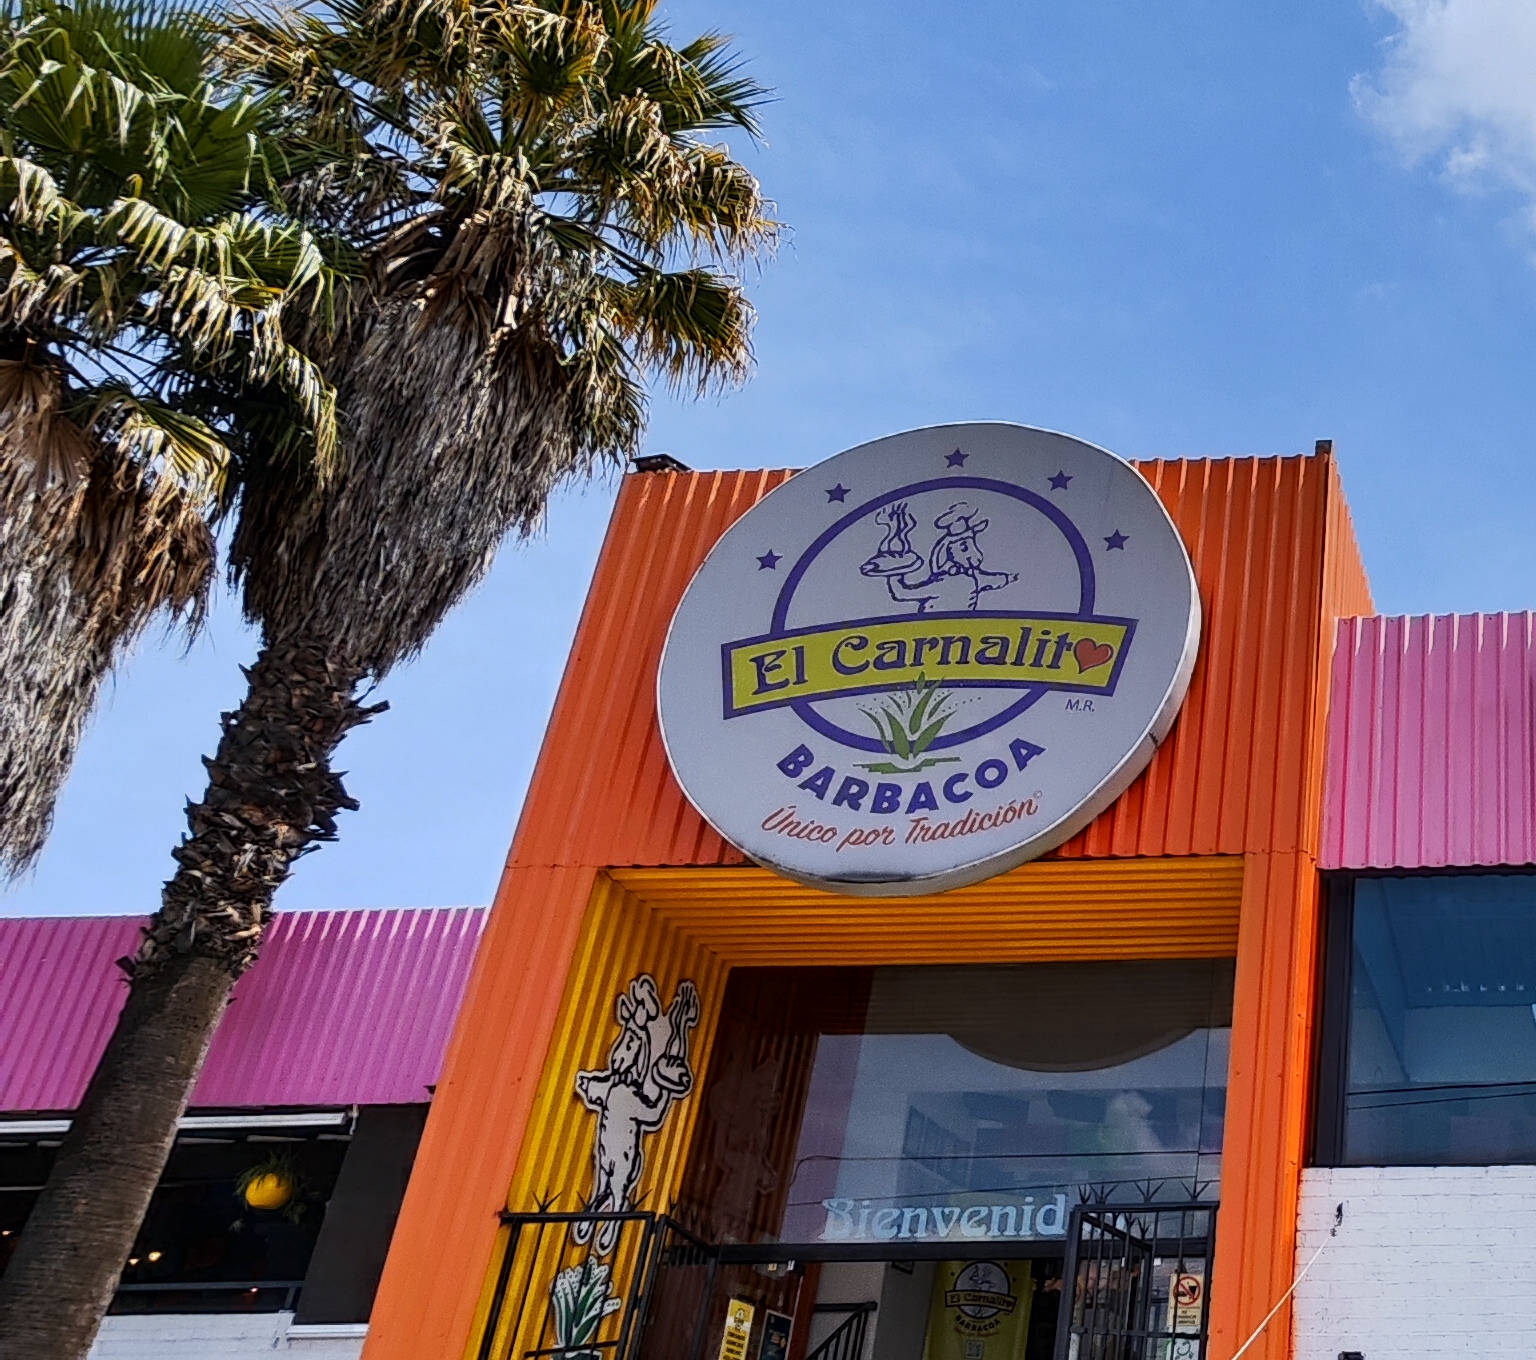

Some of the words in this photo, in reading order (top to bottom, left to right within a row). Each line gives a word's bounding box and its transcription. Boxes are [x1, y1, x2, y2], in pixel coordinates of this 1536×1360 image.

[749, 645, 808, 696] El
[776, 737, 1047, 815] BARBACOA
[760, 805, 838, 843] Único
[836, 826, 896, 853] por
[954, 1314, 1002, 1332] BARBACOA
